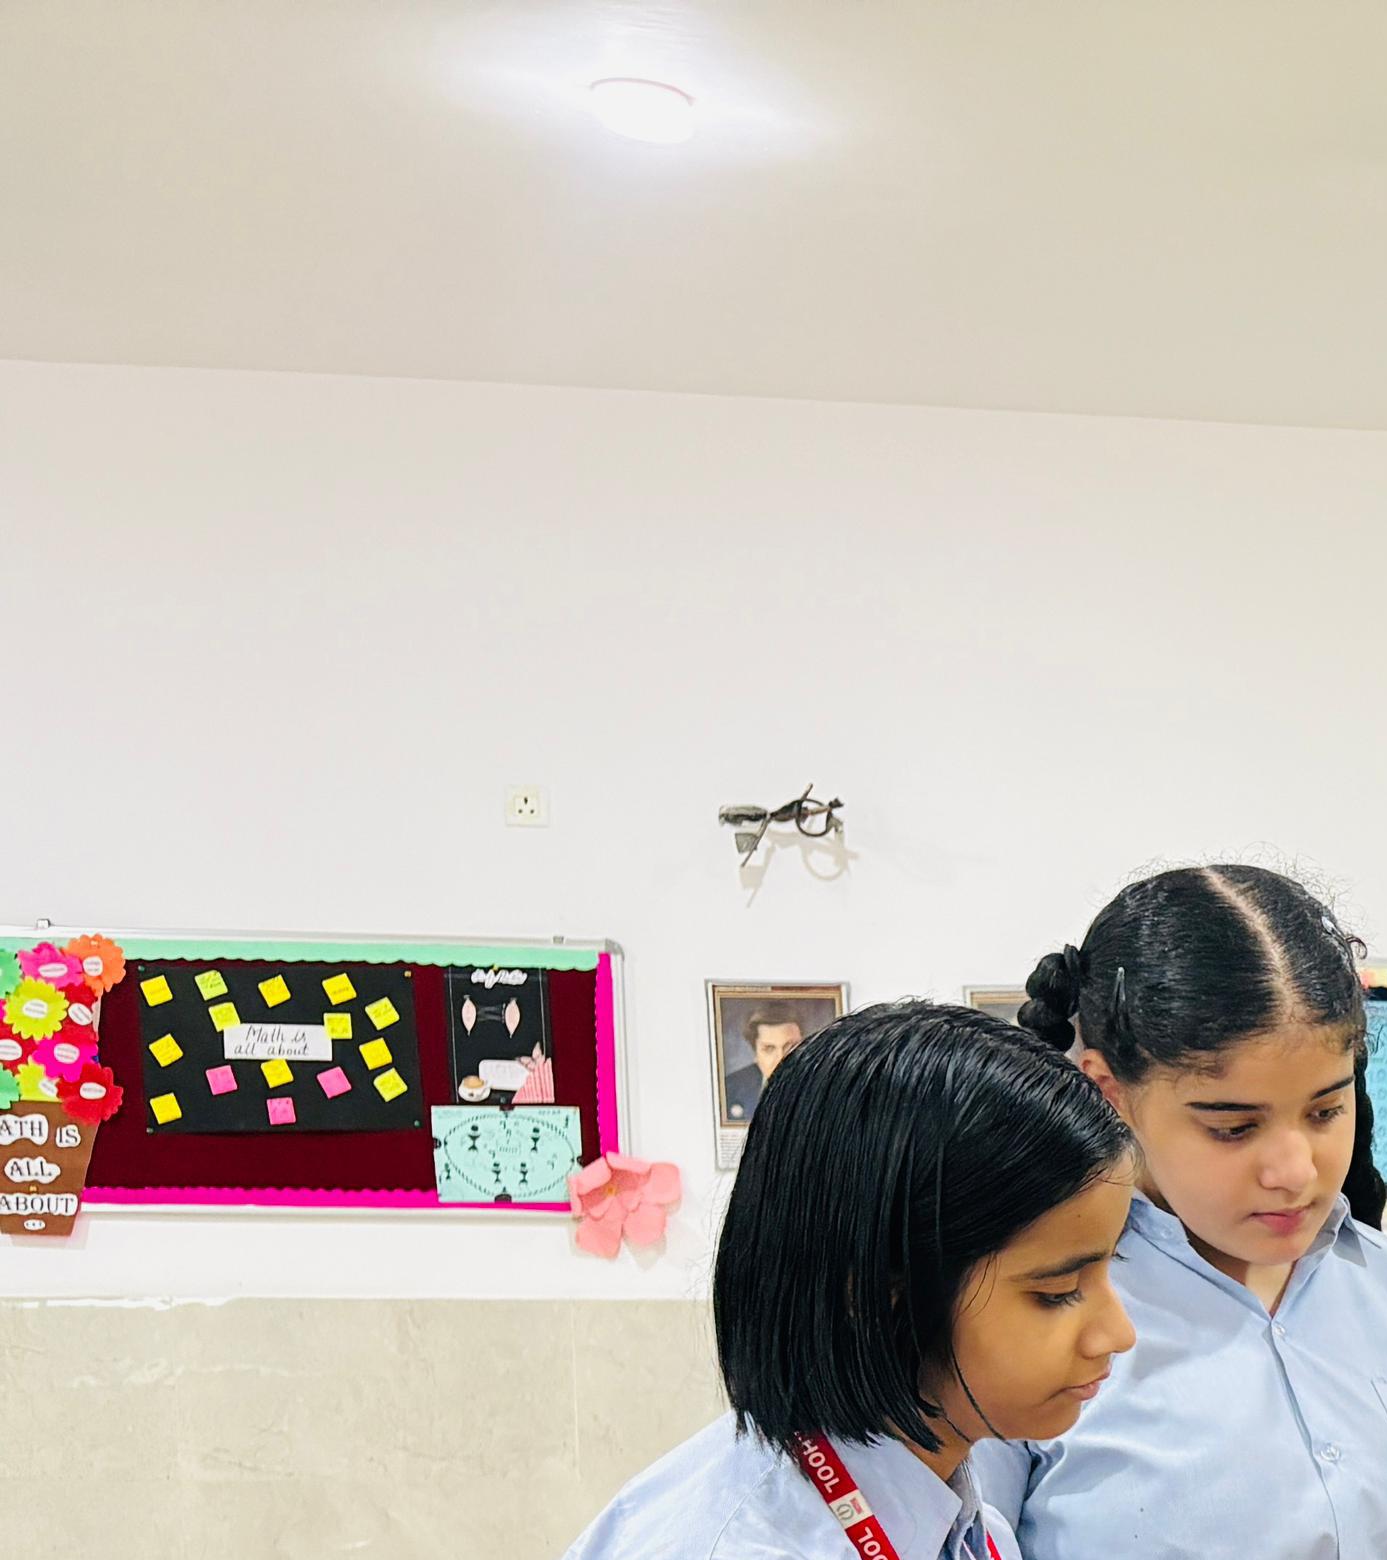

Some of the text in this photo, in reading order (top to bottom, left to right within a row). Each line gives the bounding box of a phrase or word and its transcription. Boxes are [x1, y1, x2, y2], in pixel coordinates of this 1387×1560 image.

[246, 1025, 307, 1042] Math is
[234, 1043, 309, 1056] all about
[0, 1119, 78, 1143] ATH IS
[10, 1160, 52, 1177] ALL
[0, 1196, 74, 1213] ABOUT
[801, 1438, 840, 1494] HOOL
